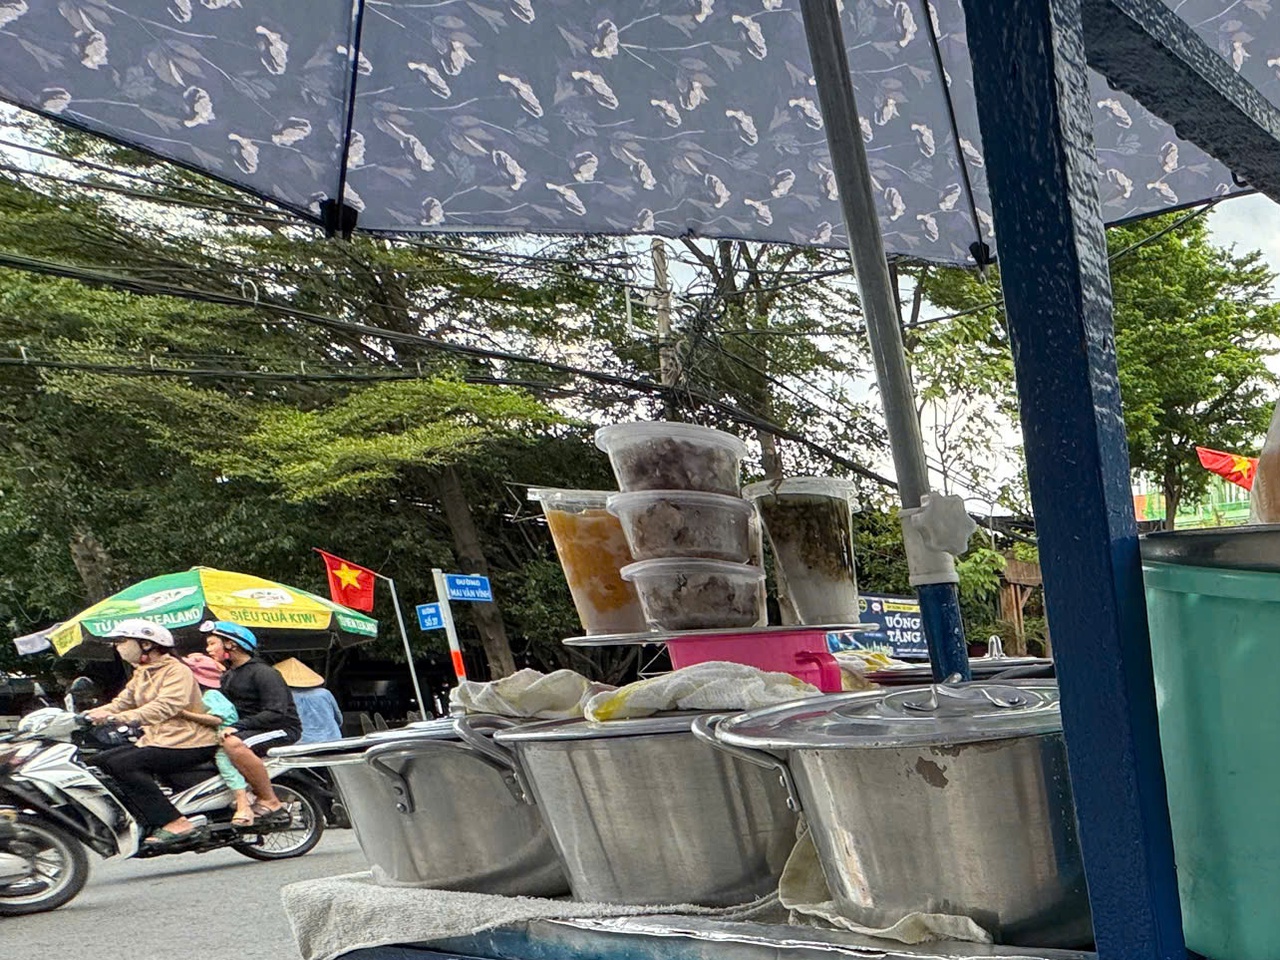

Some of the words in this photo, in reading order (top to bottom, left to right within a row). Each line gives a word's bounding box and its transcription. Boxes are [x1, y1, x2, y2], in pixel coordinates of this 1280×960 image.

[230, 609, 260, 622] SIÊU
[262, 607, 288, 623] QUẢ
[290, 612, 318, 624] KIWI
[884, 613, 921, 629] UỐNG
[887, 629, 921, 646] TẶNG
